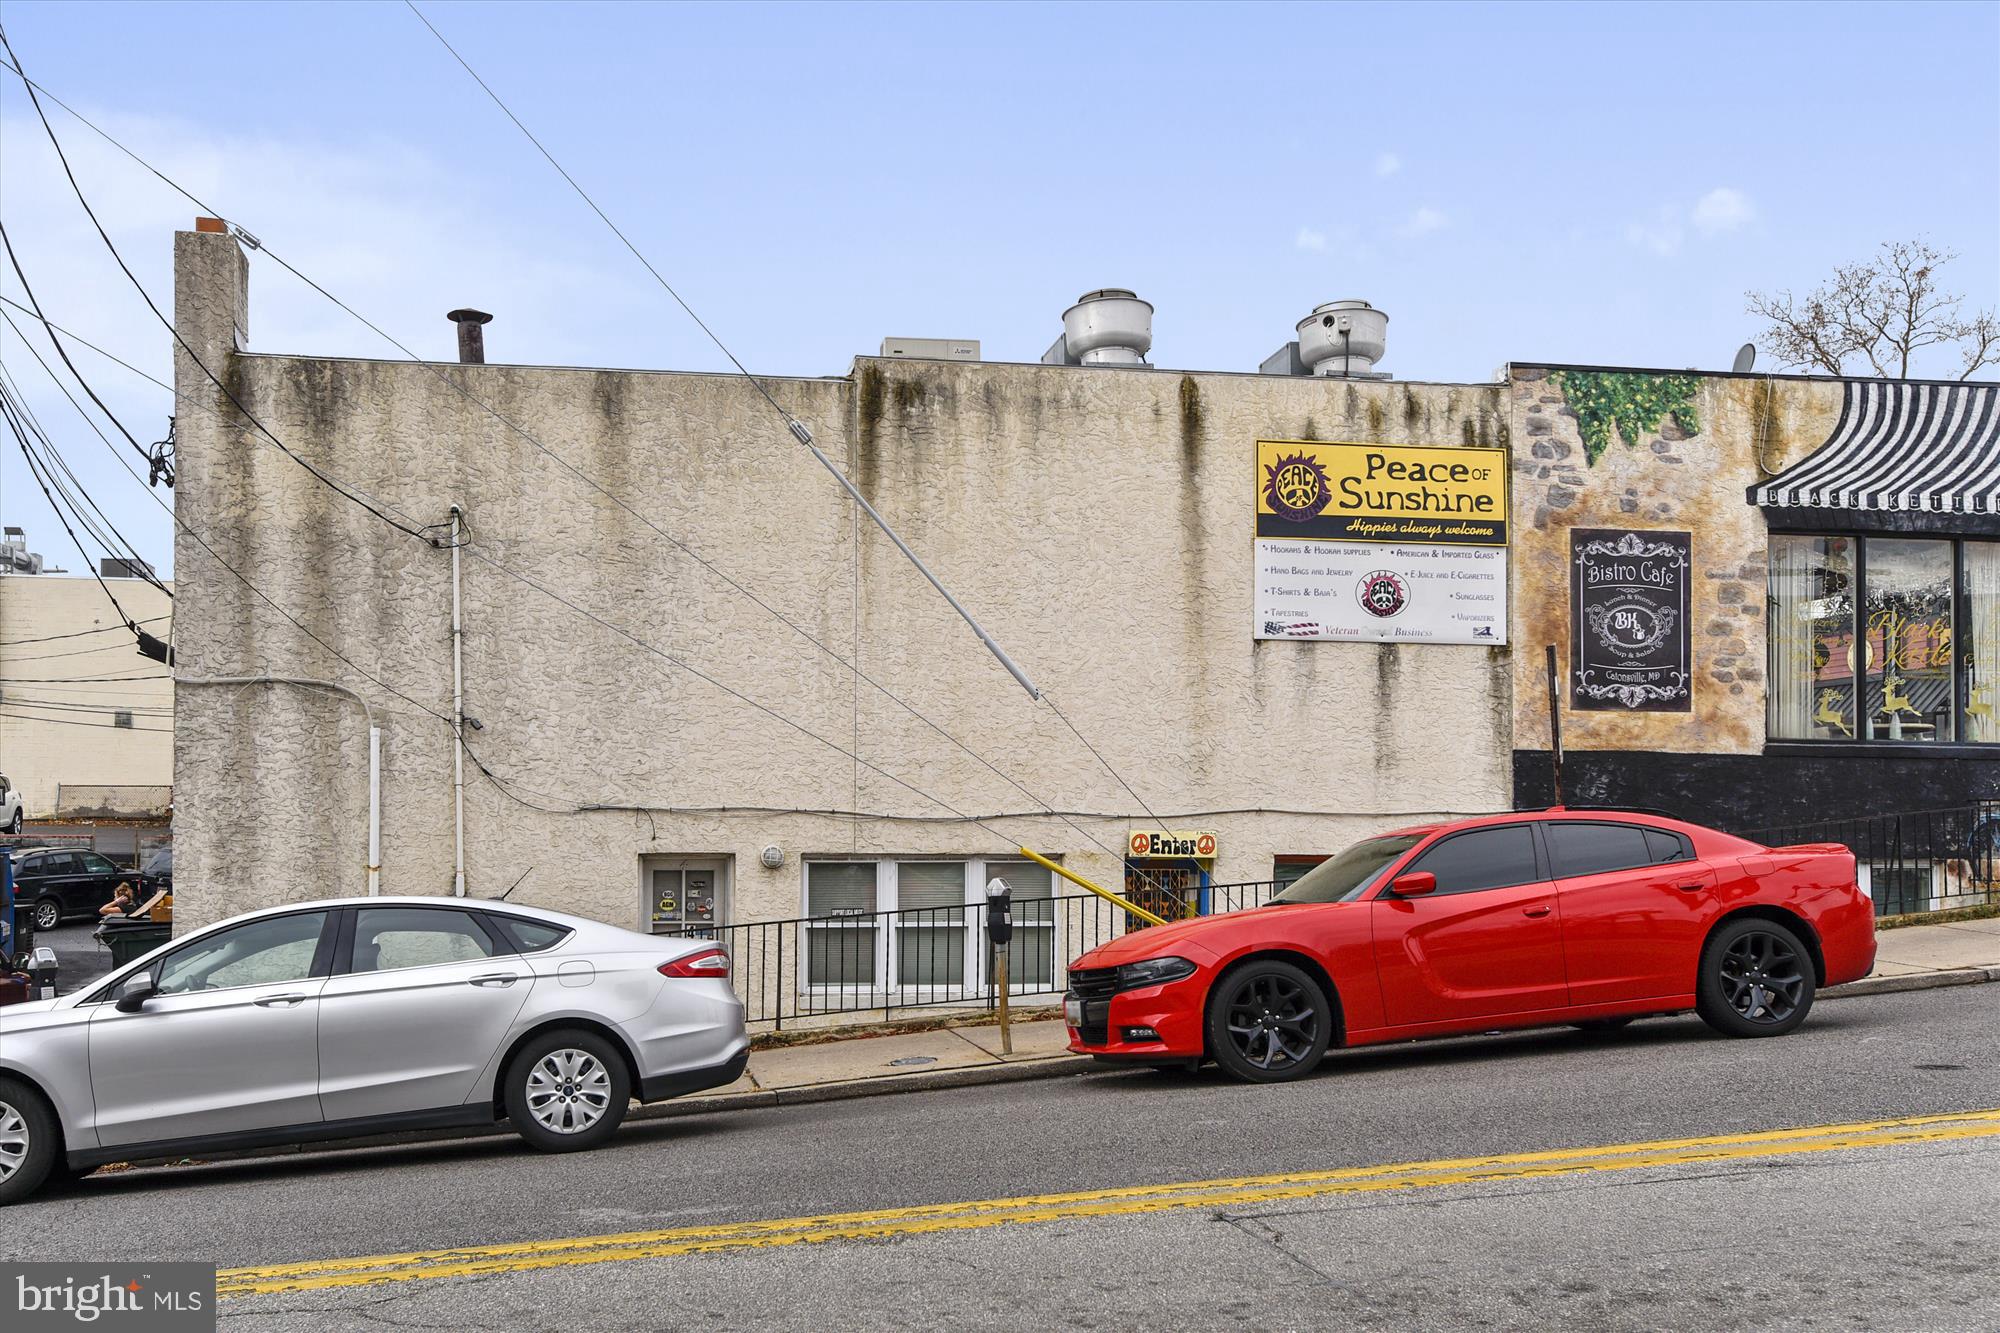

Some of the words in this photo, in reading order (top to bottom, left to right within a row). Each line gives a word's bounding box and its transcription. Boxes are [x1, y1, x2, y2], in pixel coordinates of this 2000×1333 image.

[1366, 453, 1469, 483] Peace
[1472, 468, 1491, 481] OF
[1339, 476, 1494, 513] Sunshine
[1346, 518, 1398, 536] Hippies
[1400, 520, 1442, 538] always
[1444, 521, 1494, 536] welcome
[1304, 546, 1312, 554] &
[1343, 548, 1371, 556] SUPPLIES
[1396, 549, 1429, 558] AMERICAN
[1431, 550, 1439, 558] &
[1441, 550, 1472, 559] IMPORTED
[1474, 551, 1494, 559] GLASS
[1588, 562, 1637, 584] Bistro
[1640, 561, 1674, 587] Cafe
[1303, 588, 1311, 596] &
[1325, 625, 1359, 635] Veteran
[1395, 627, 1432, 637] Business
[1867, 609, 1944, 640] Black
[1648, 671, 1661, 681] MD
[1149, 834, 1197, 855] Enter
